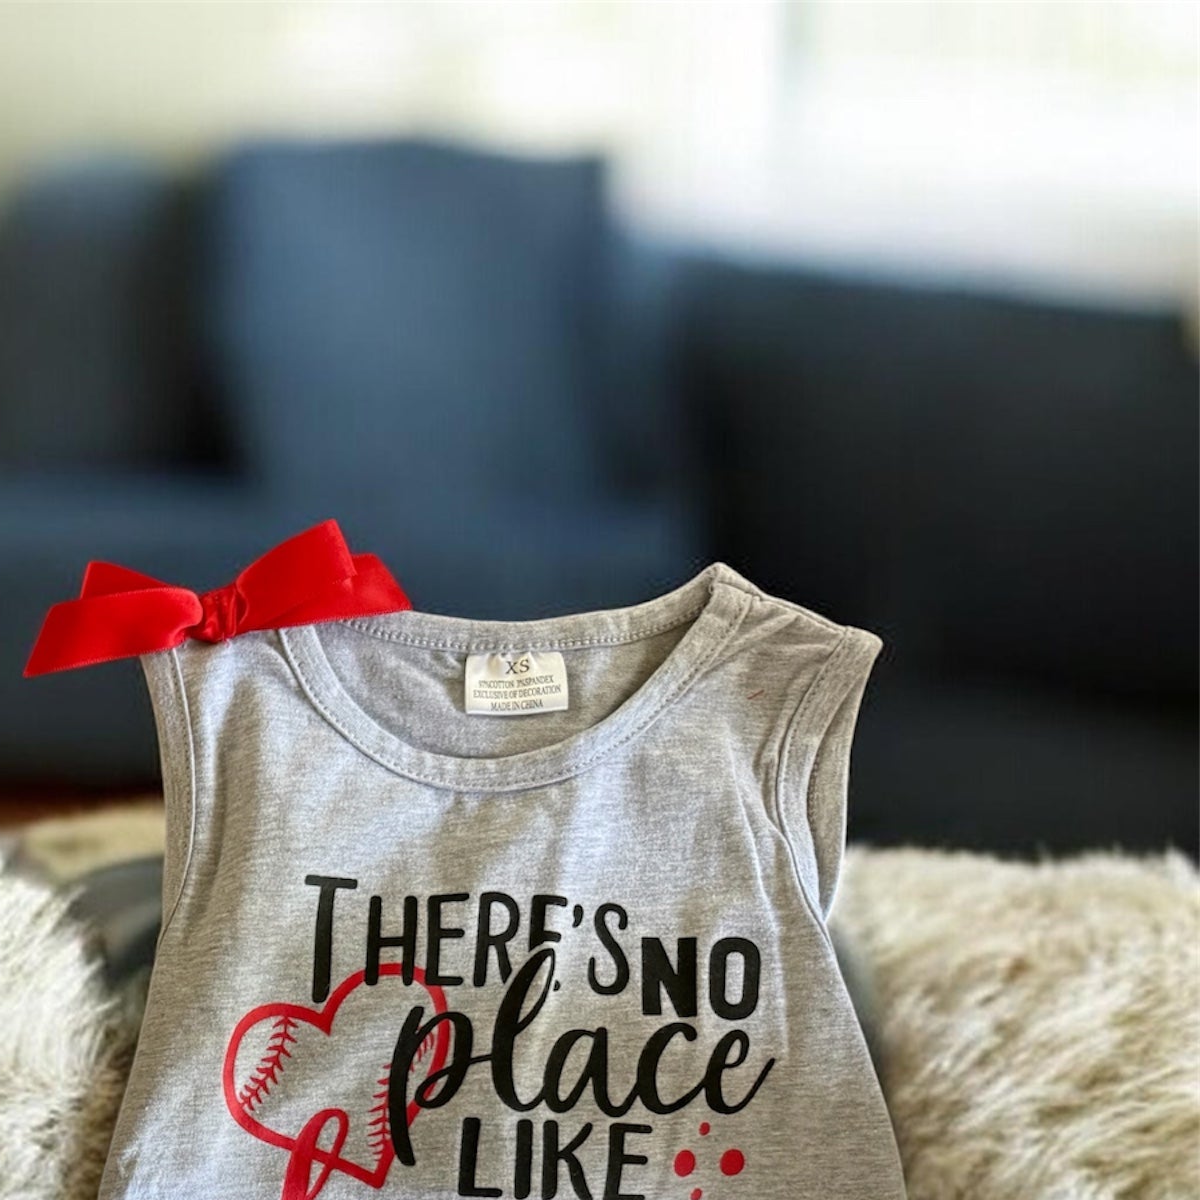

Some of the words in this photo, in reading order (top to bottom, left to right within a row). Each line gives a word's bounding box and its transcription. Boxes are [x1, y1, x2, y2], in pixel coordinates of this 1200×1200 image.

[505, 659, 530, 675] XS
[473, 689, 508, 699] EXCLUSIVE
[519, 684, 562, 698] DECORATION
[490, 701, 511, 712] MADE
[521, 699, 544, 710] CHINA
[304, 875, 630, 1003] THERE'S
[641, 936, 761, 1020] NO
[388, 946, 776, 1167] place
